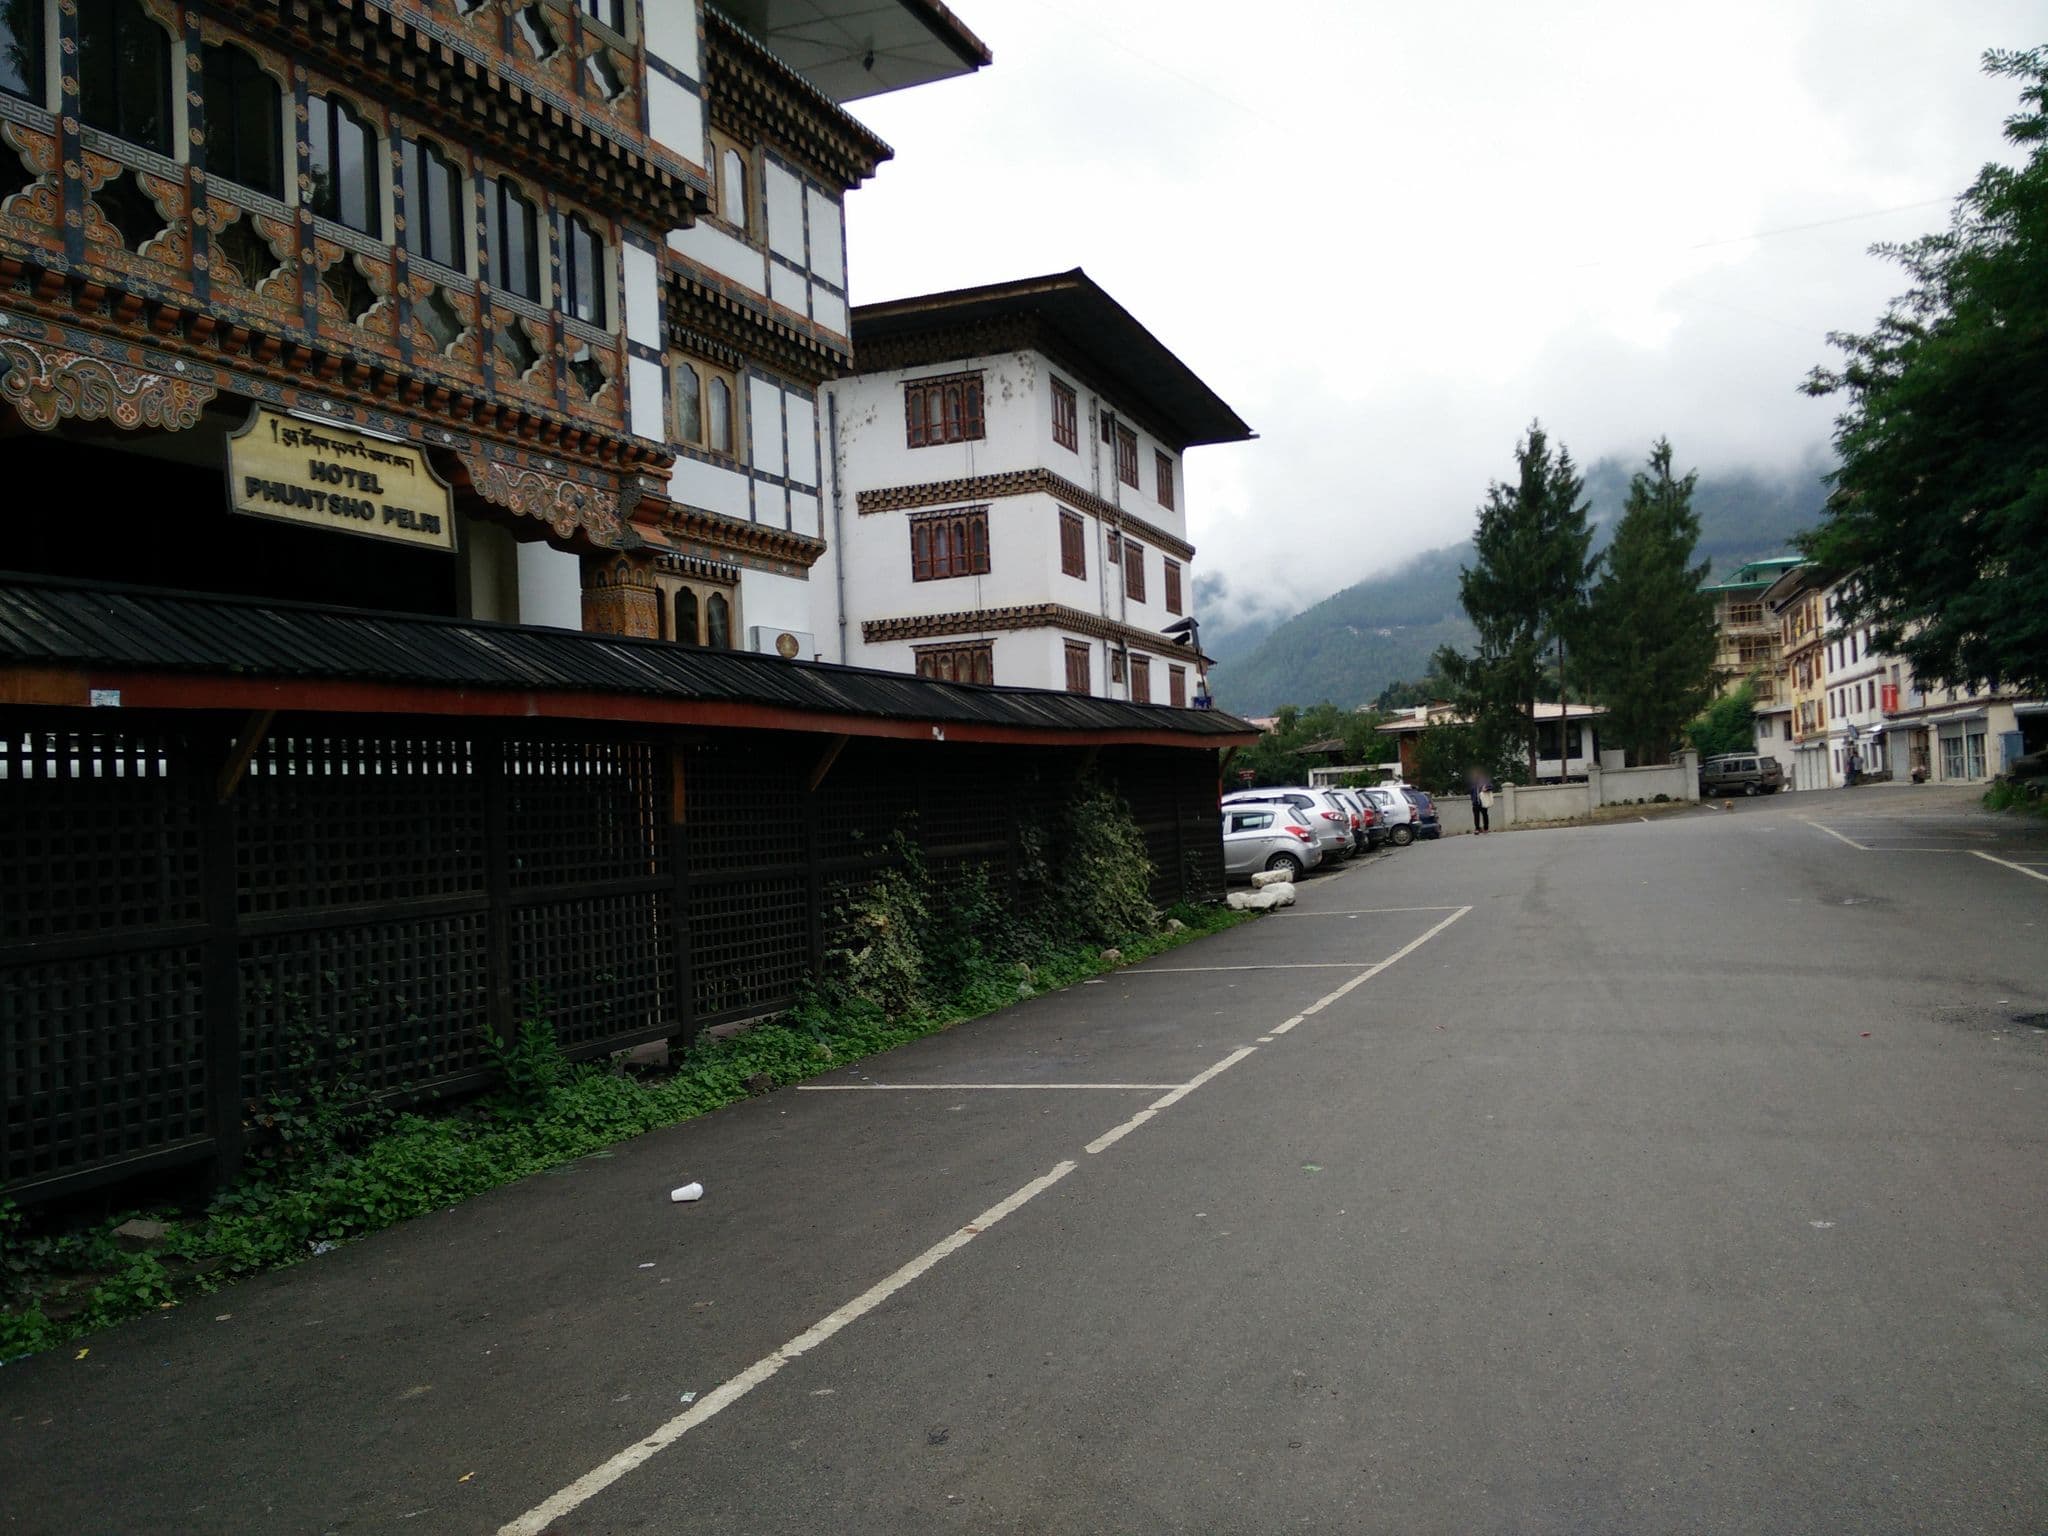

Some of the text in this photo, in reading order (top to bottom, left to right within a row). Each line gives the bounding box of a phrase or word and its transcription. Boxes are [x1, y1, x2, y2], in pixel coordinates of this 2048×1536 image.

[308, 458, 384, 495] HOTEL
[244, 475, 442, 535] PHUNTSHO PELRI
